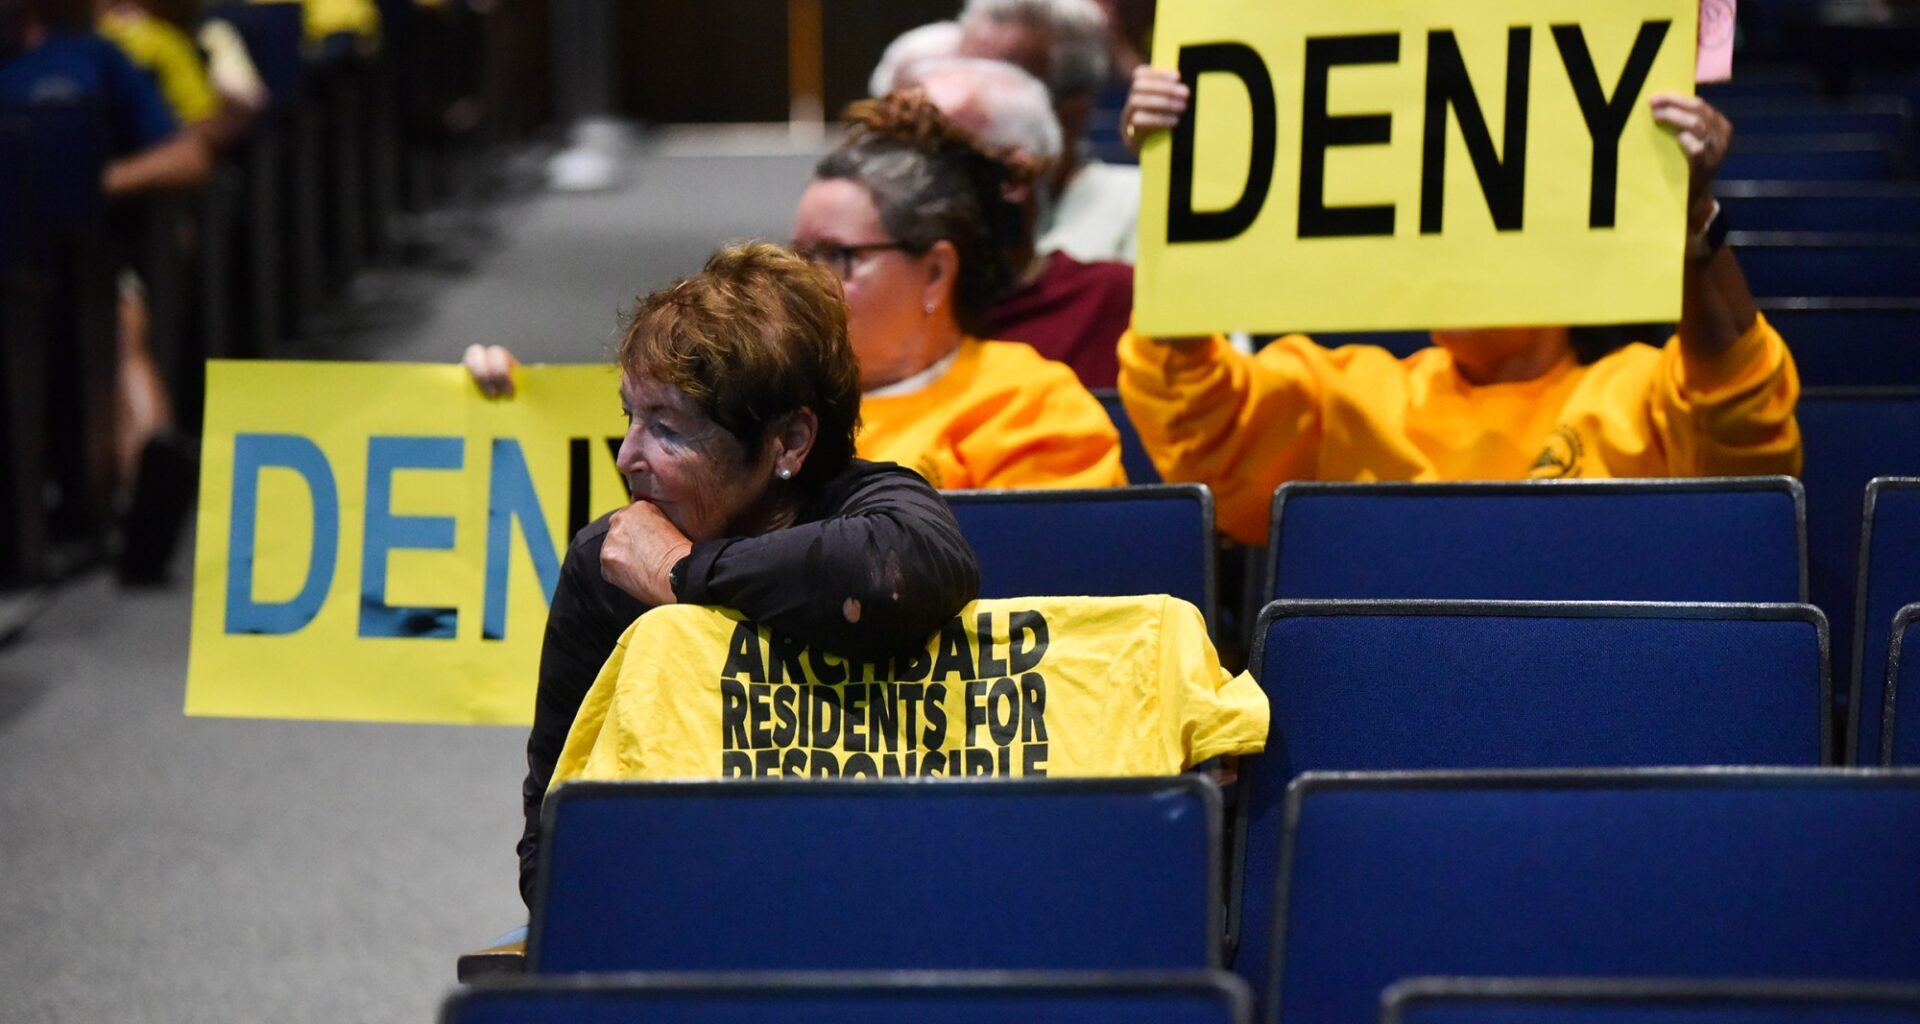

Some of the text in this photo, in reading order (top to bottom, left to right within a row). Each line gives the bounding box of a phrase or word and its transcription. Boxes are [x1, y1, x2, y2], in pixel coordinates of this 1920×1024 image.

[1166, 20, 1673, 245] DENY
[225, 433, 633, 641] DEN
[720, 671, 1049, 753] RESIDENTS FOR
